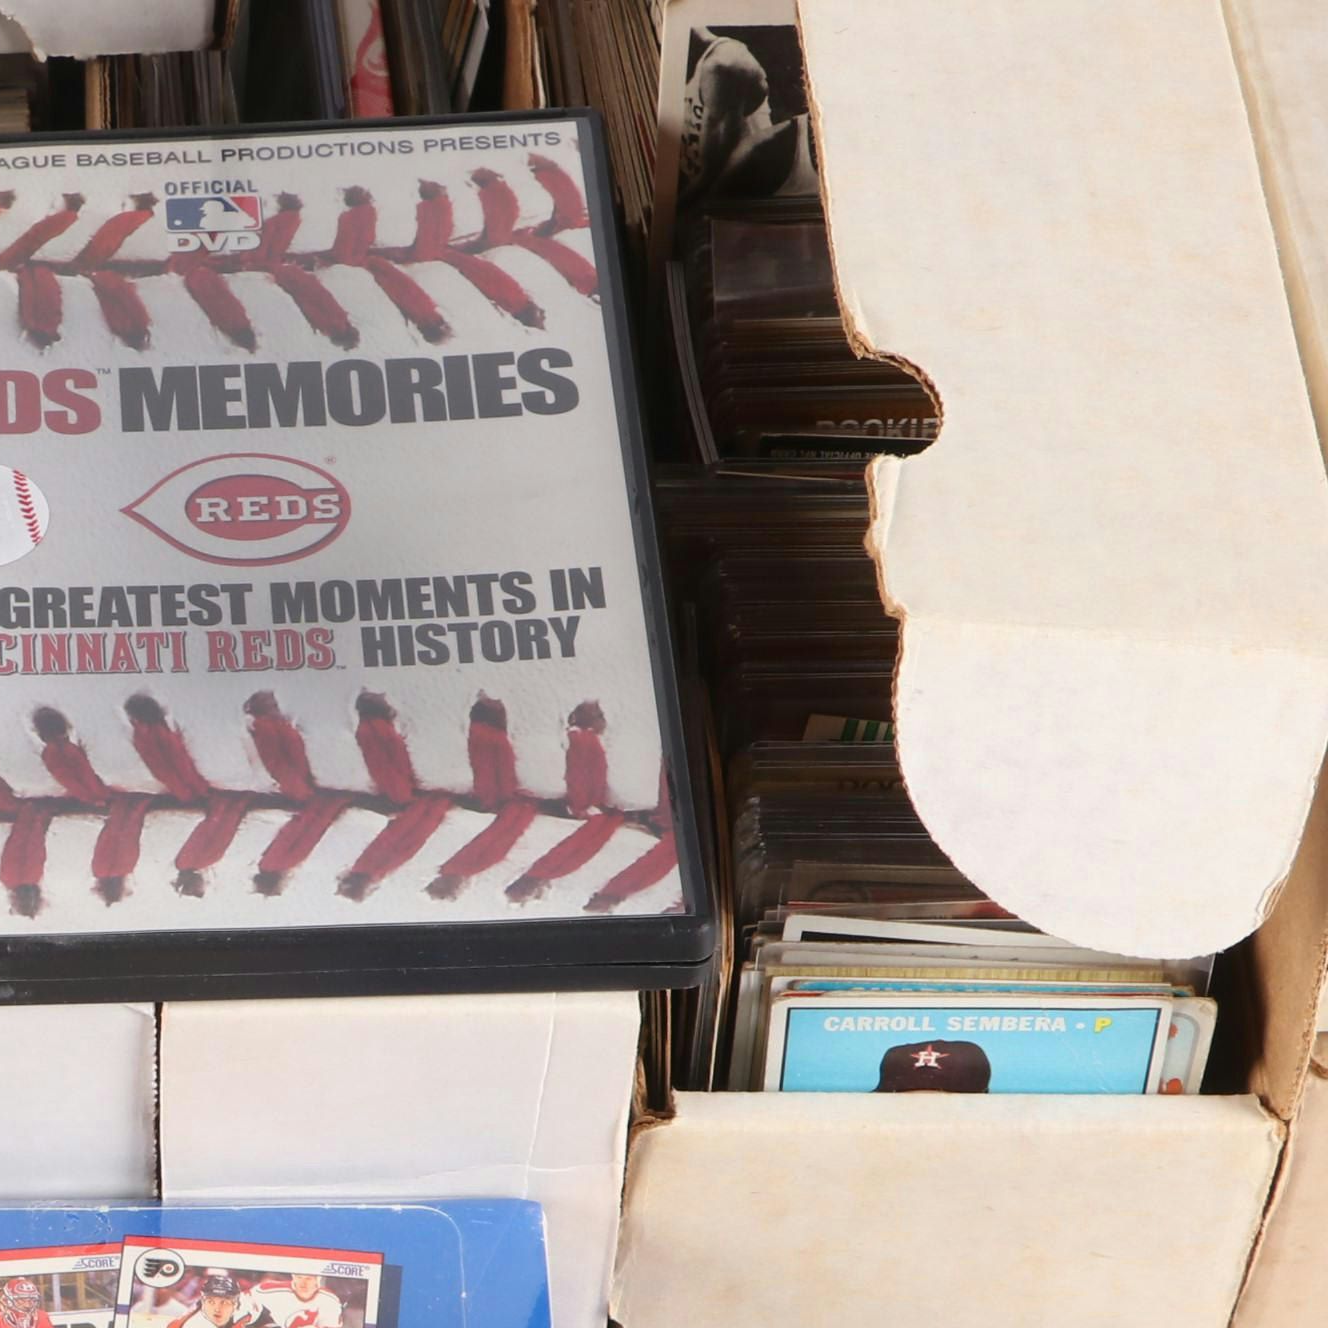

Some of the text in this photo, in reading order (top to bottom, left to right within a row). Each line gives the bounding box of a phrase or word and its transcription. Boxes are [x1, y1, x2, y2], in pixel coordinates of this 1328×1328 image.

[76, 149, 212, 168] BASEBALL
[221, 139, 415, 162] PRODUCTIONS
[423, 131, 562, 154] PRESENTS
[164, 180, 258, 196] OFFICIAL
[168, 232, 262, 253] DVD
[118, 347, 580, 433] MEMORIES
[195, 492, 341, 523] REDS
[269, 571, 537, 625] MOMENTS
[549, 566, 607, 612] IN
[206, 627, 338, 673] REDS
[360, 615, 581, 668] HISTORY
[823, 1014, 1113, 1034] CARROLL SEMBERA P
